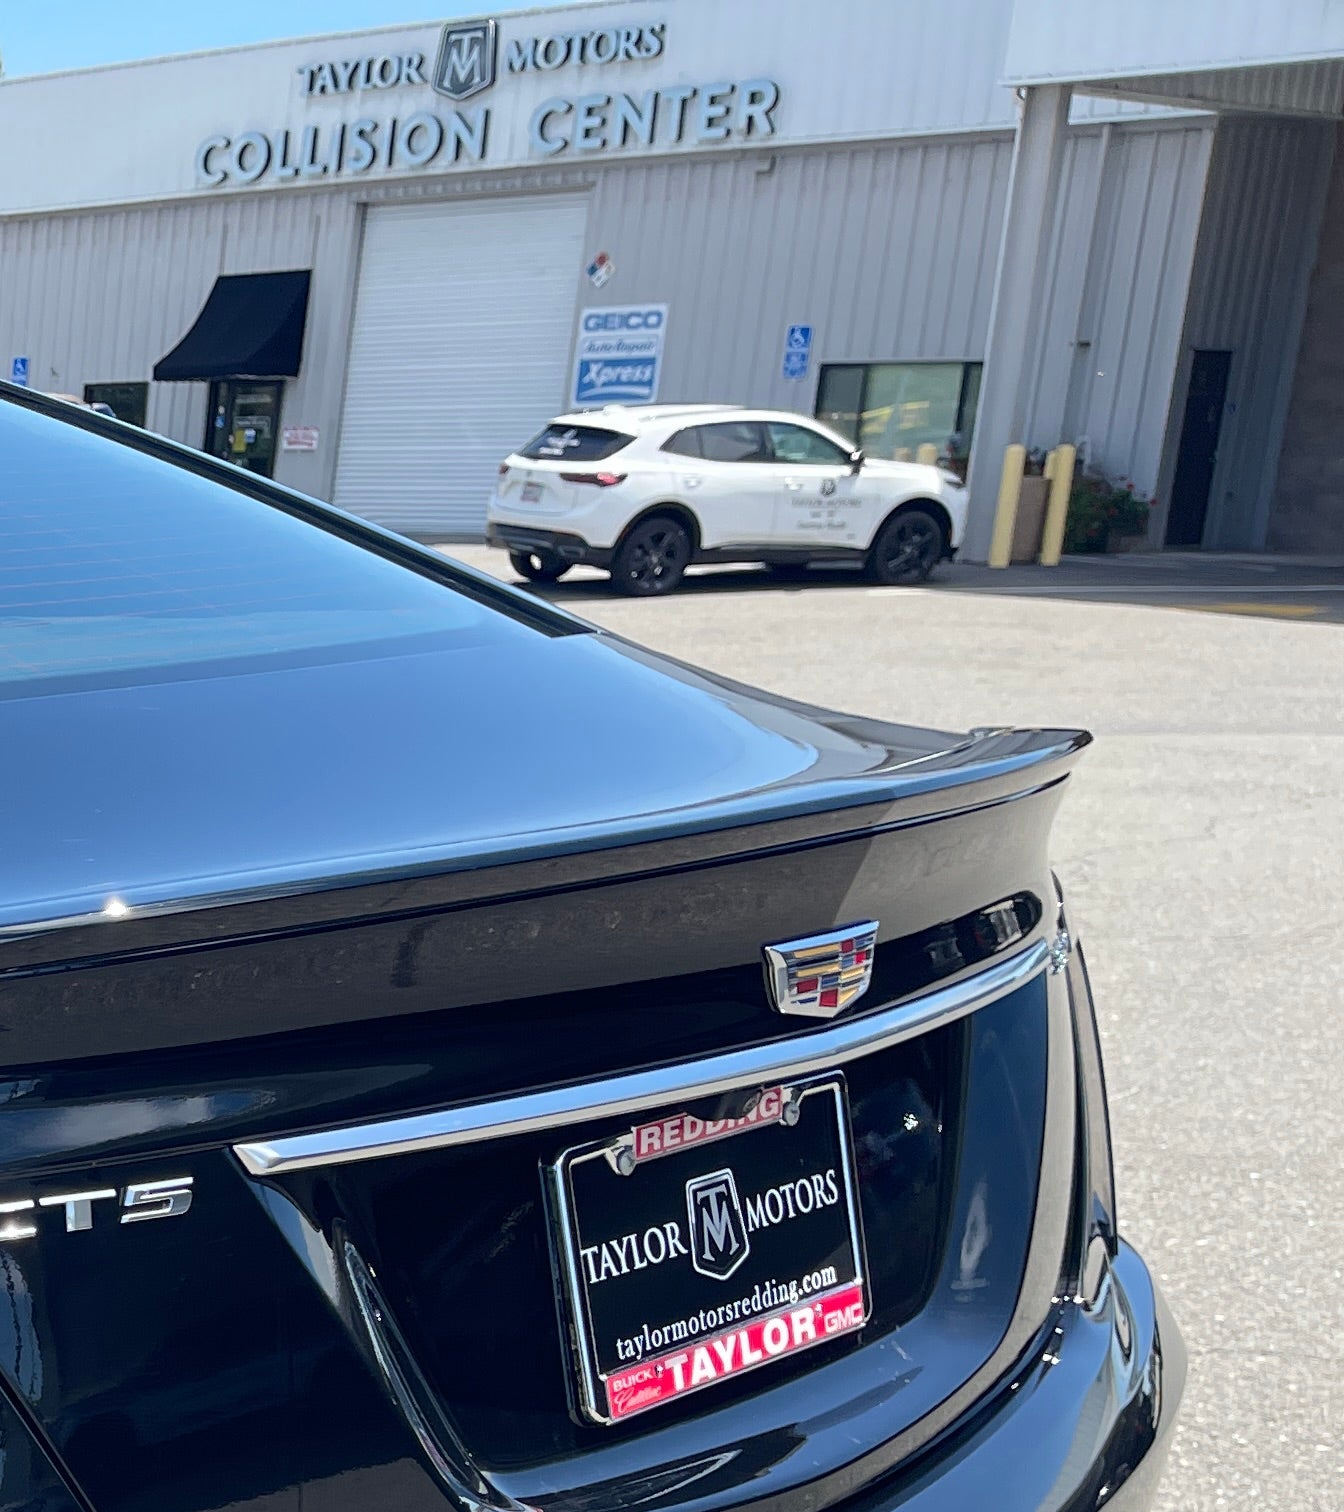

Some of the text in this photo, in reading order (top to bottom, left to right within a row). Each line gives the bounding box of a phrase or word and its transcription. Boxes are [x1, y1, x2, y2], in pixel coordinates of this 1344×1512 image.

[297, 52, 428, 96] TAYLOR
[506, 23, 665, 73] MOTORS
[196, 79, 779, 186] COLLISION CENTER
[584, 310, 662, 331] GEICO
[581, 361, 653, 387] Xpress
[580, 1221, 688, 1284] TAYLOR
[746, 1168, 839, 1232] MOTORS
[616, 1265, 837, 1361] taylormotorsredding.com
[664, 1307, 816, 1392] TAYLOR
[824, 1301, 863, 1332] GMC
[613, 1368, 654, 1392] BUICK
